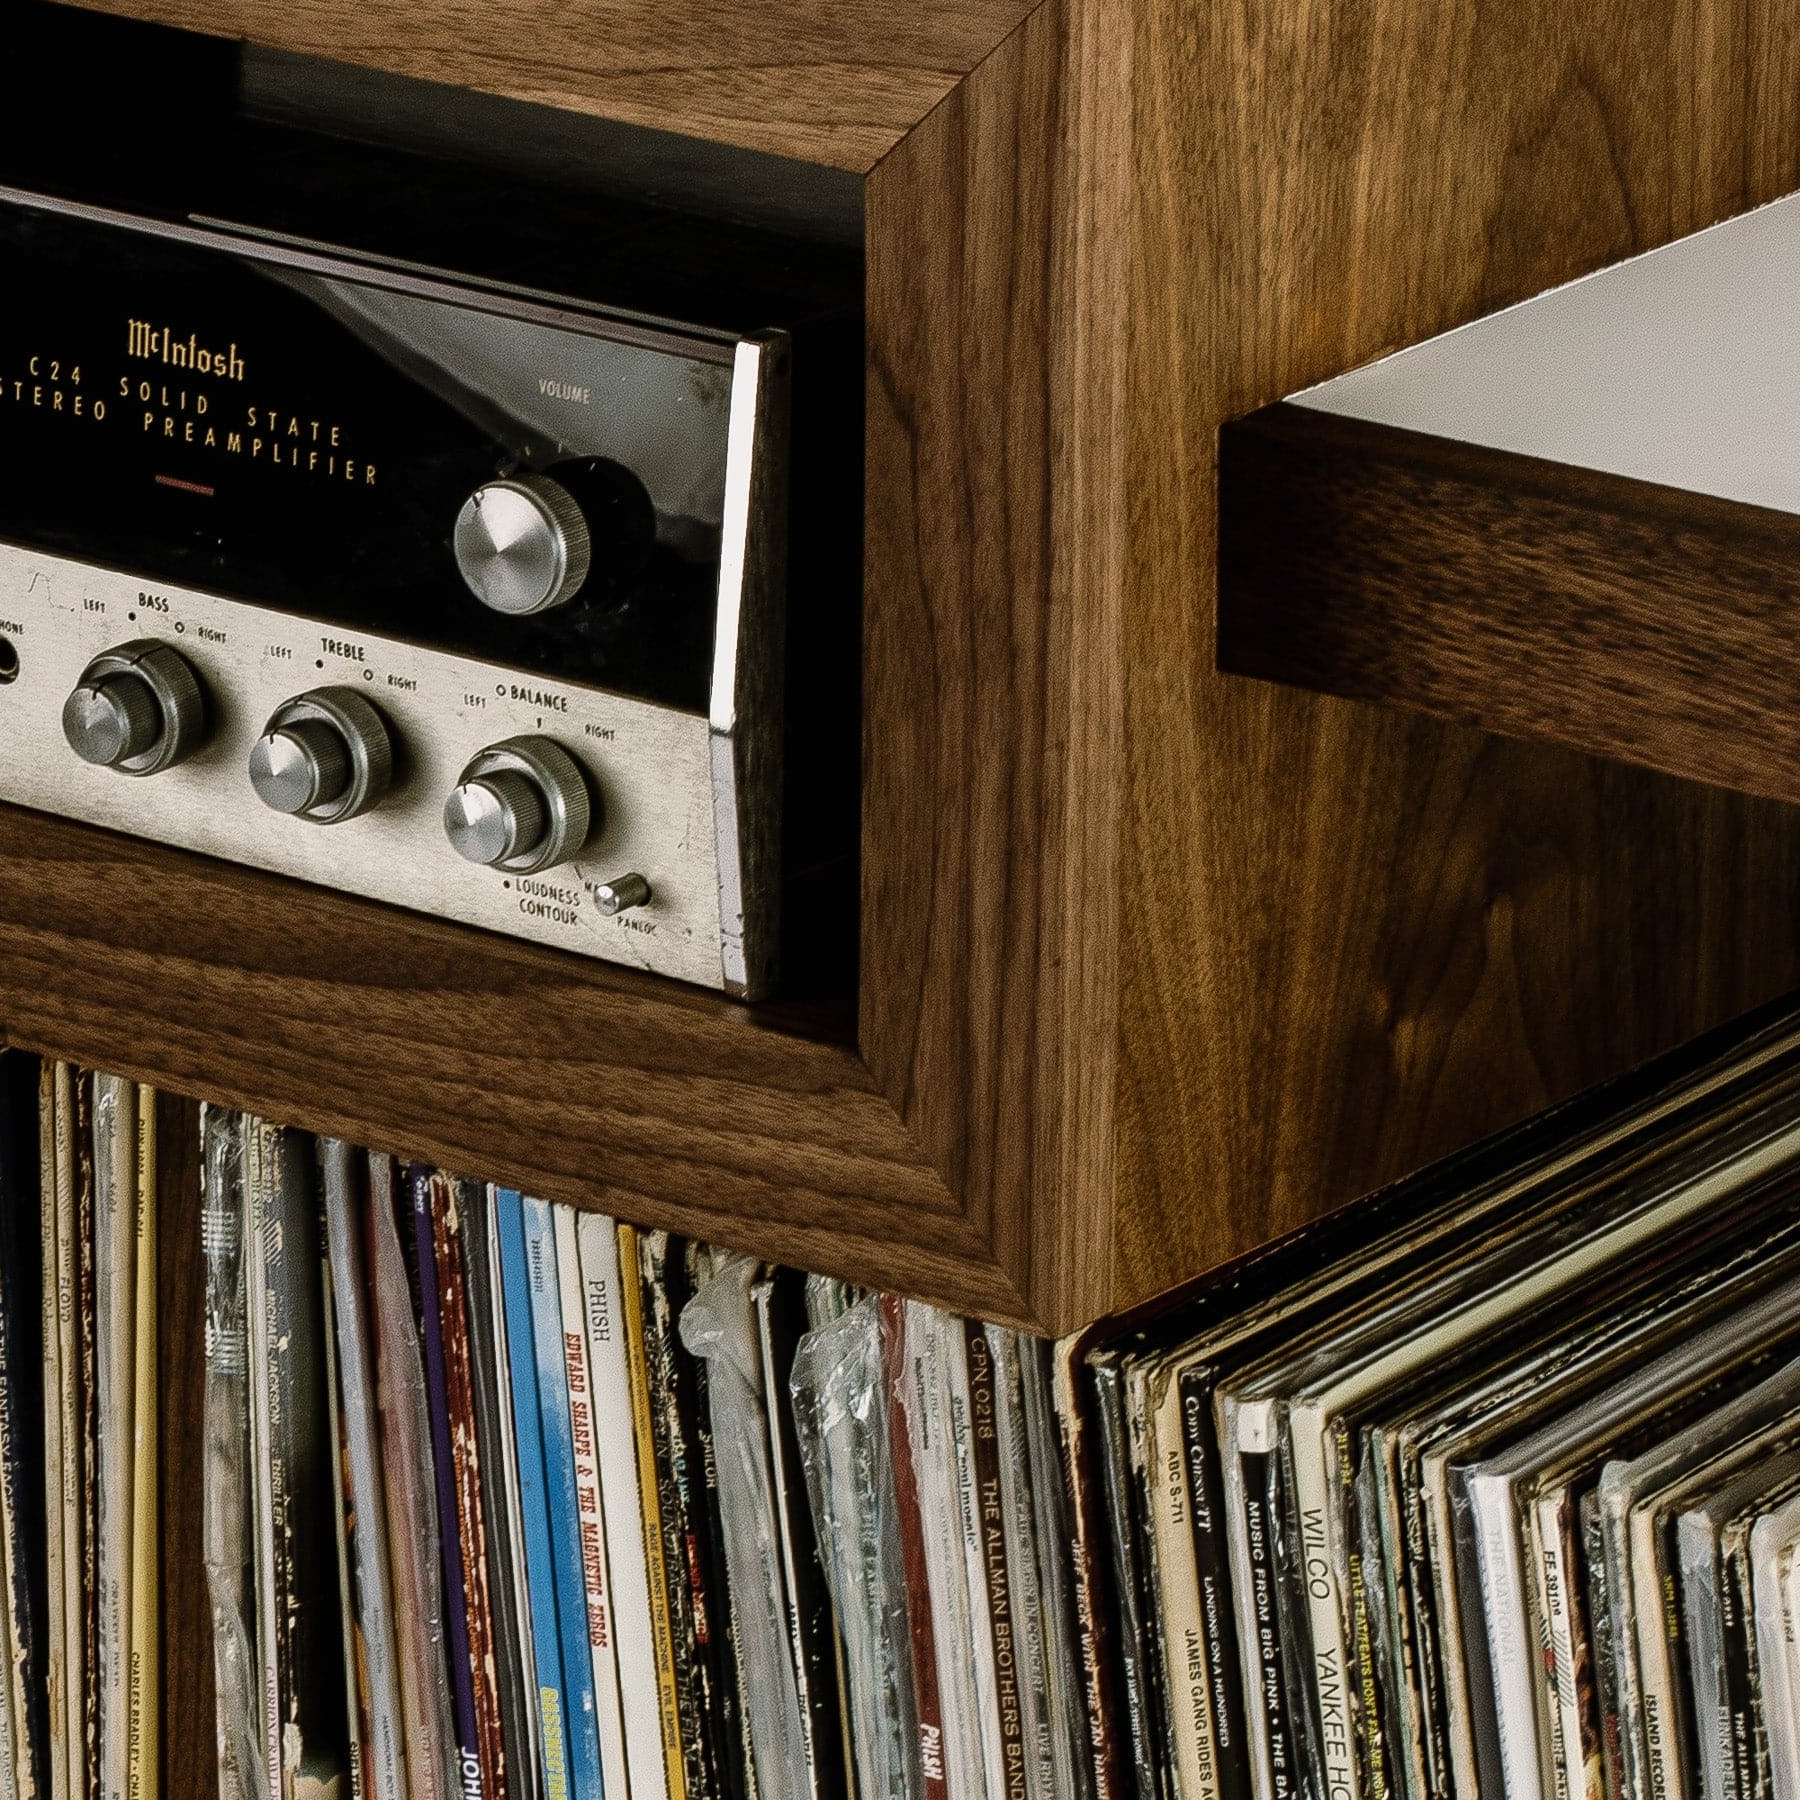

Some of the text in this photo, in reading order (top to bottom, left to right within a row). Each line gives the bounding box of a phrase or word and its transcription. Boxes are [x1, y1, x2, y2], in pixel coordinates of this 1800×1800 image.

[128, 317, 245, 382] McIntosh
[119, 377, 208, 415] SOLID
[248, 407, 341, 448] STATE
[538, 378, 592, 406] VOLUME
[144, 413, 377, 485] PREAMPLIFIER
[83, 598, 105, 614] LEFT
[138, 592, 170, 614] BASS
[198, 627, 227, 644] RIGHT
[270, 646, 292, 660] LEFT
[320, 637, 366, 662] TREBLE
[387, 673, 418, 692] RIGHT
[463, 694, 487, 709] LEFT
[510, 685, 568, 713] BALANCE
[585, 723, 616, 742] RIGHT
[515, 878, 581, 907] LOUDNESS
[519, 898, 578, 926] CONTOUR
[588, 1279, 609, 1342] PHISH
[564, 1331, 586, 1393] EDWARD
[571, 1399, 592, 1458] SHARPE
[578, 1485, 596, 1514] THE
[1167, 1449, 1186, 1524] ABC S-711
[969, 1335, 1019, 1736] CPN 0218 THE ALLMAN BROTHERS
[1247, 1500, 1265, 1561] MUSIC
[581, 1520, 603, 1596] MAGNETIC
[1301, 1508, 1330, 1601] WILCO
[1254, 1566, 1271, 1622] FROM
[588, 1601, 607, 1648] ZEROS
[1259, 1626, 1275, 1660] BIG
[1184, 1627, 1202, 1681] JAMES
[129, 1651, 140, 1706] CHARLES
[1263, 1666, 1279, 1711] PINK
[1190, 1685, 1207, 1731] GANG
[1315, 1647, 1347, 1758] YANKEE
[129, 1709, 139, 1763] BRADLEY
[919, 1721, 943, 1780] PHISH
[1195, 1735, 1212, 1782] RIDES
[1270, 1732, 1285, 1769] THE
